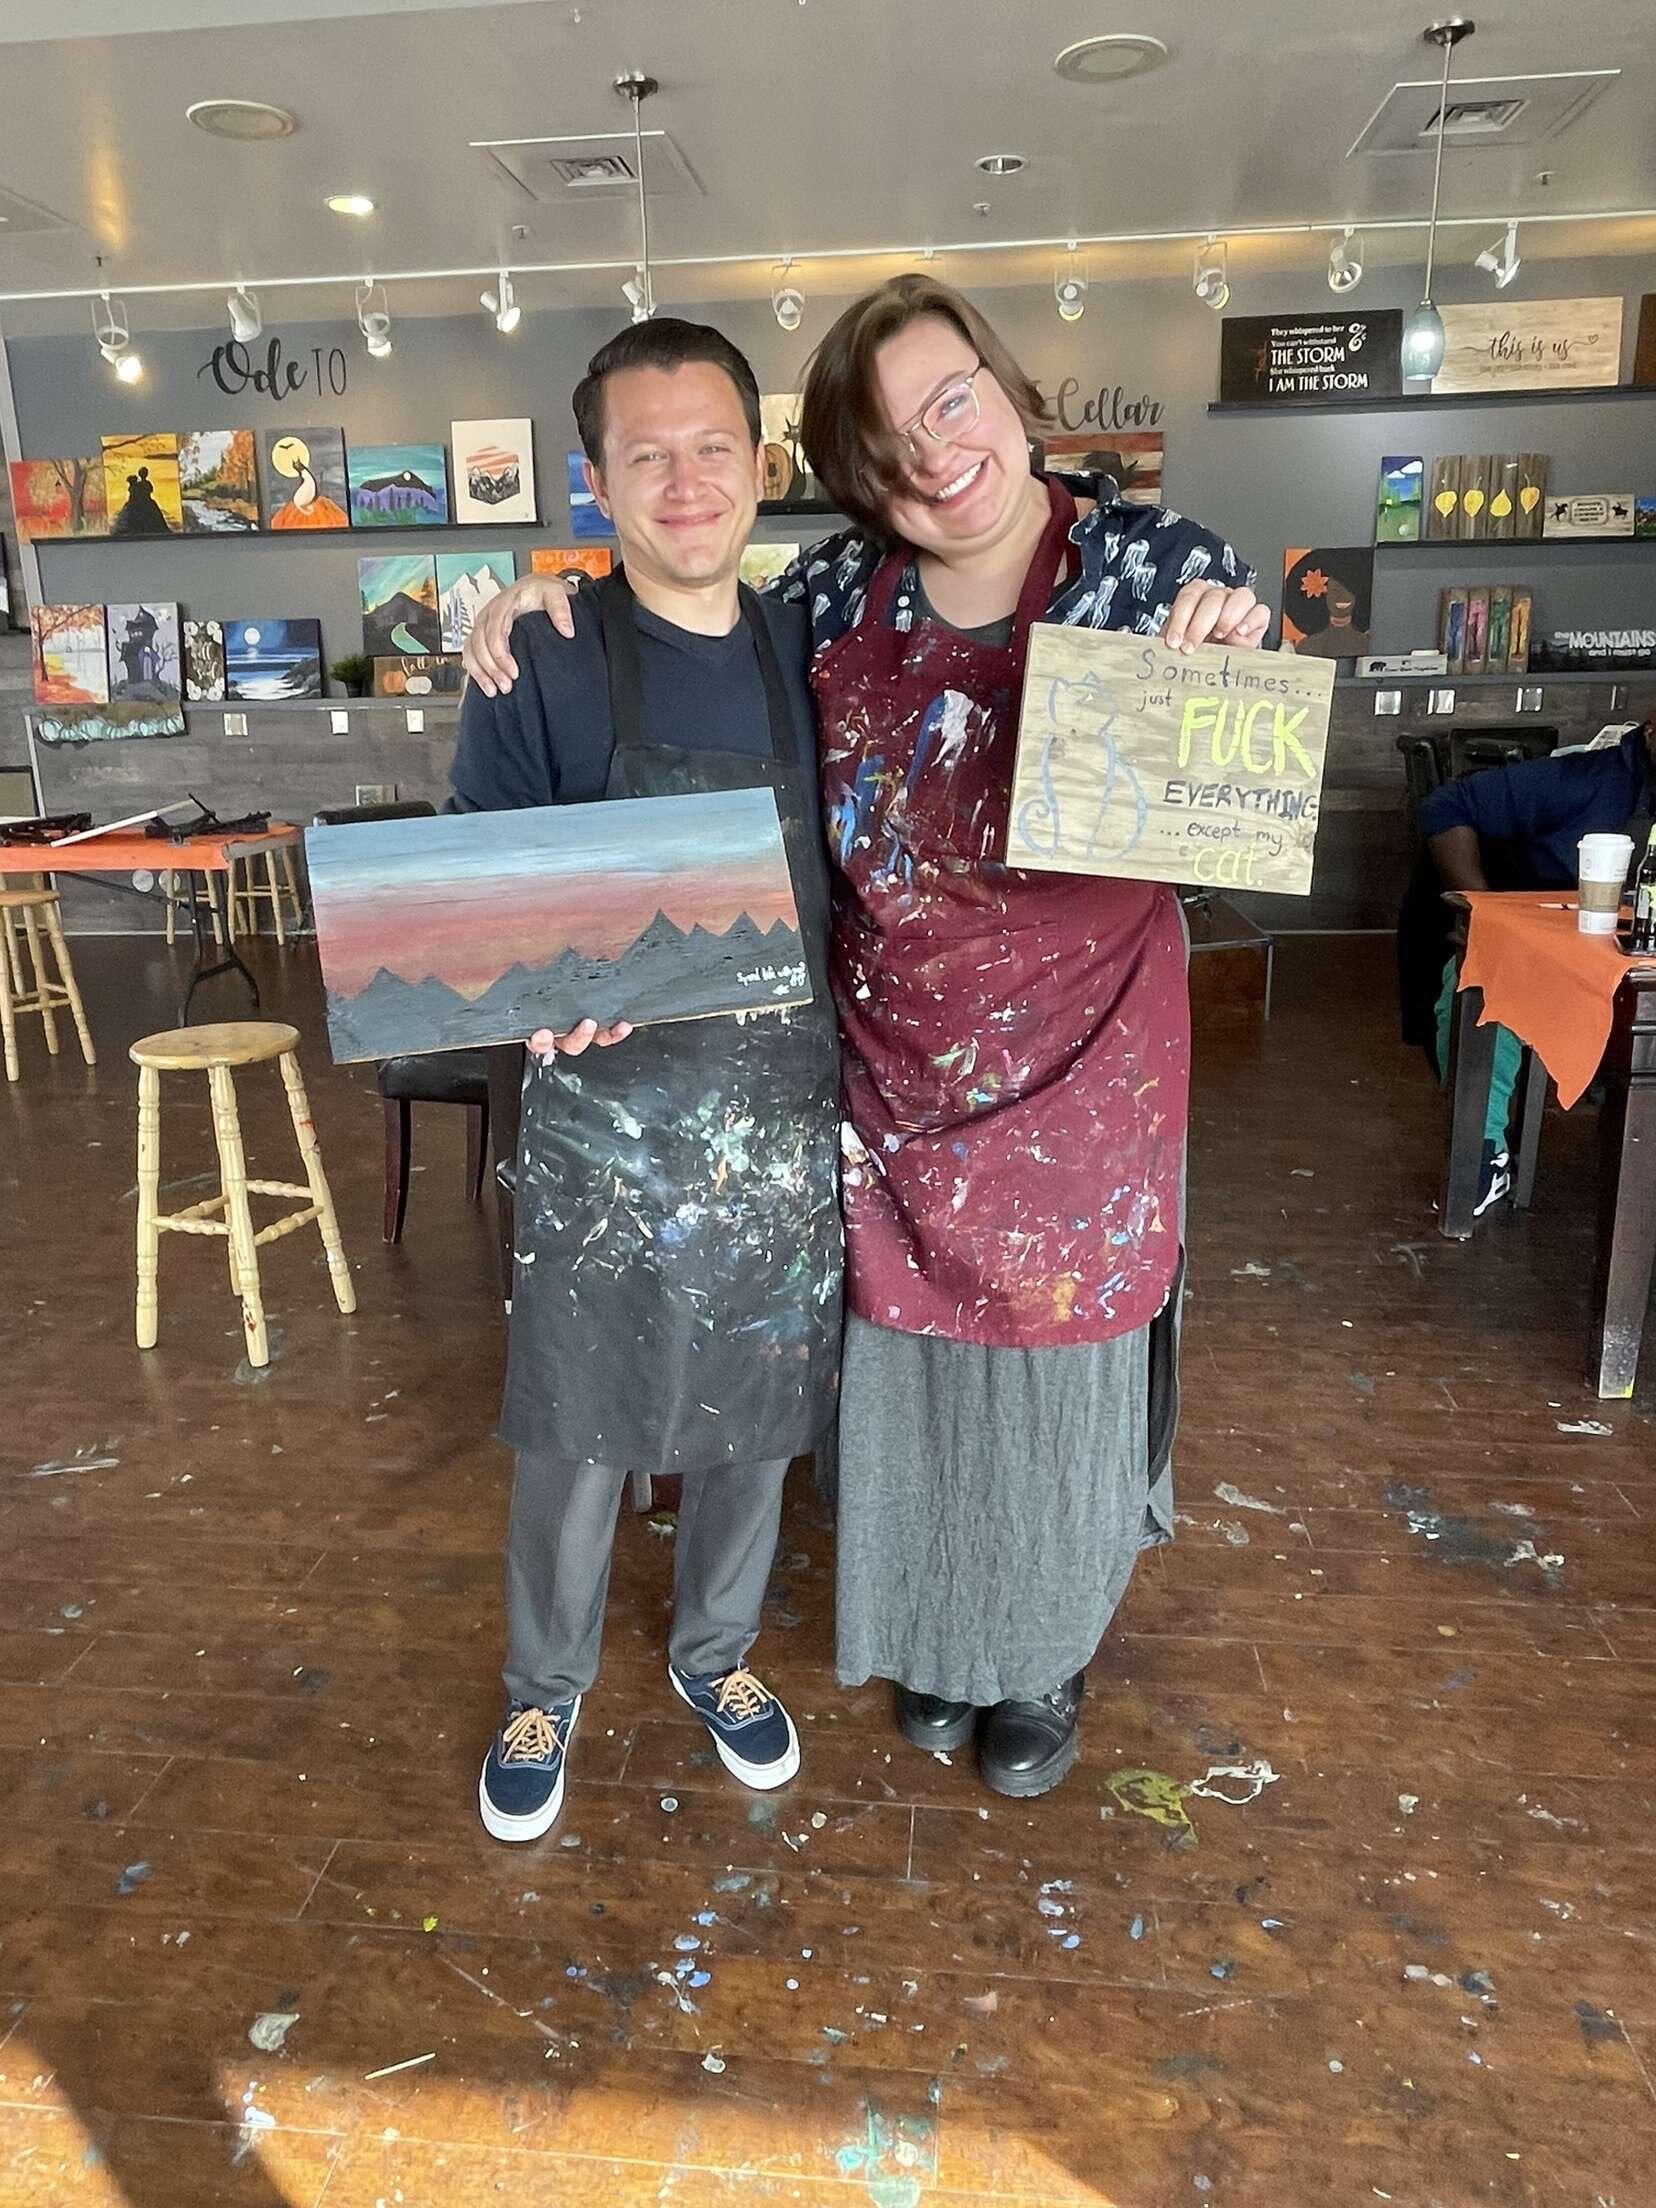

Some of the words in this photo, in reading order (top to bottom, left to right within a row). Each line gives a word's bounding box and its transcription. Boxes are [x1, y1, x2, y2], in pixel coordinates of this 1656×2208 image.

[1271, 348, 1294, 366] THE
[1296, 345, 1345, 365] STORM
[1489, 330, 1523, 362] this
[1531, 336, 1545, 361] is
[1552, 339, 1570, 361] us
[197, 337, 308, 401] Ode
[311, 348, 347, 396] TO
[1269, 378, 1273, 392] I
[1276, 377, 1295, 392] AM
[1298, 375, 1320, 391] THE
[1322, 373, 1368, 391] STORM
[1057, 377, 1165, 432] Cellar
[1569, 630, 1656, 649] MOUNTAINS
[1136, 690, 1172, 713] just
[1177, 696, 1317, 779] FUCK
[1256, 830, 1283, 856] my
